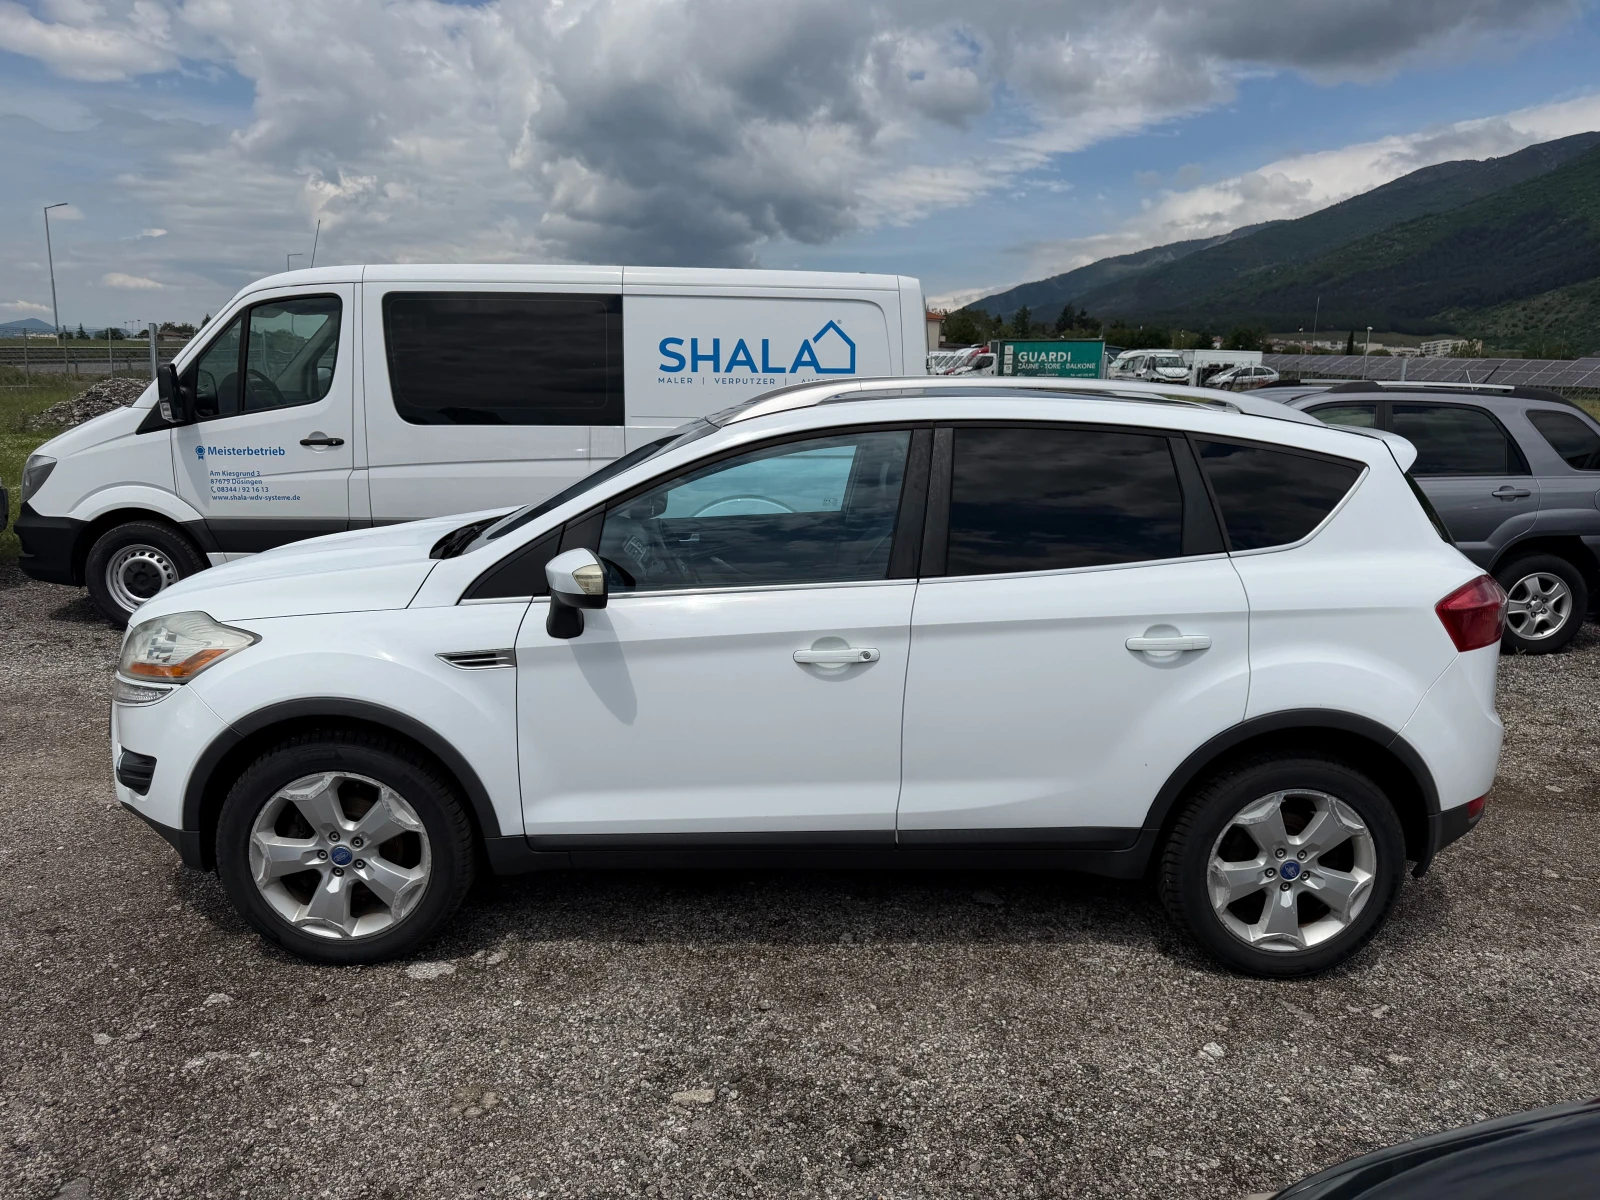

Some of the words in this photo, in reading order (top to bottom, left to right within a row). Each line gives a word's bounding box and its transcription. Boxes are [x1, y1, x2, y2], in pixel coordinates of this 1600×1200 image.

[658, 337, 822, 373] SHALA
[1018, 351, 1071, 362] GUARDI
[1017, 362, 1040, 370] ZÄUNE
[714, 377, 776, 385] VERPUTZER
[207, 446, 286, 456] Meisterbetrieb
[222, 470, 256, 479] Kiesgrund
[232, 478, 263, 486] Dösingen
[211, 494, 301, 502] www.shala-wdv-systeme.de
